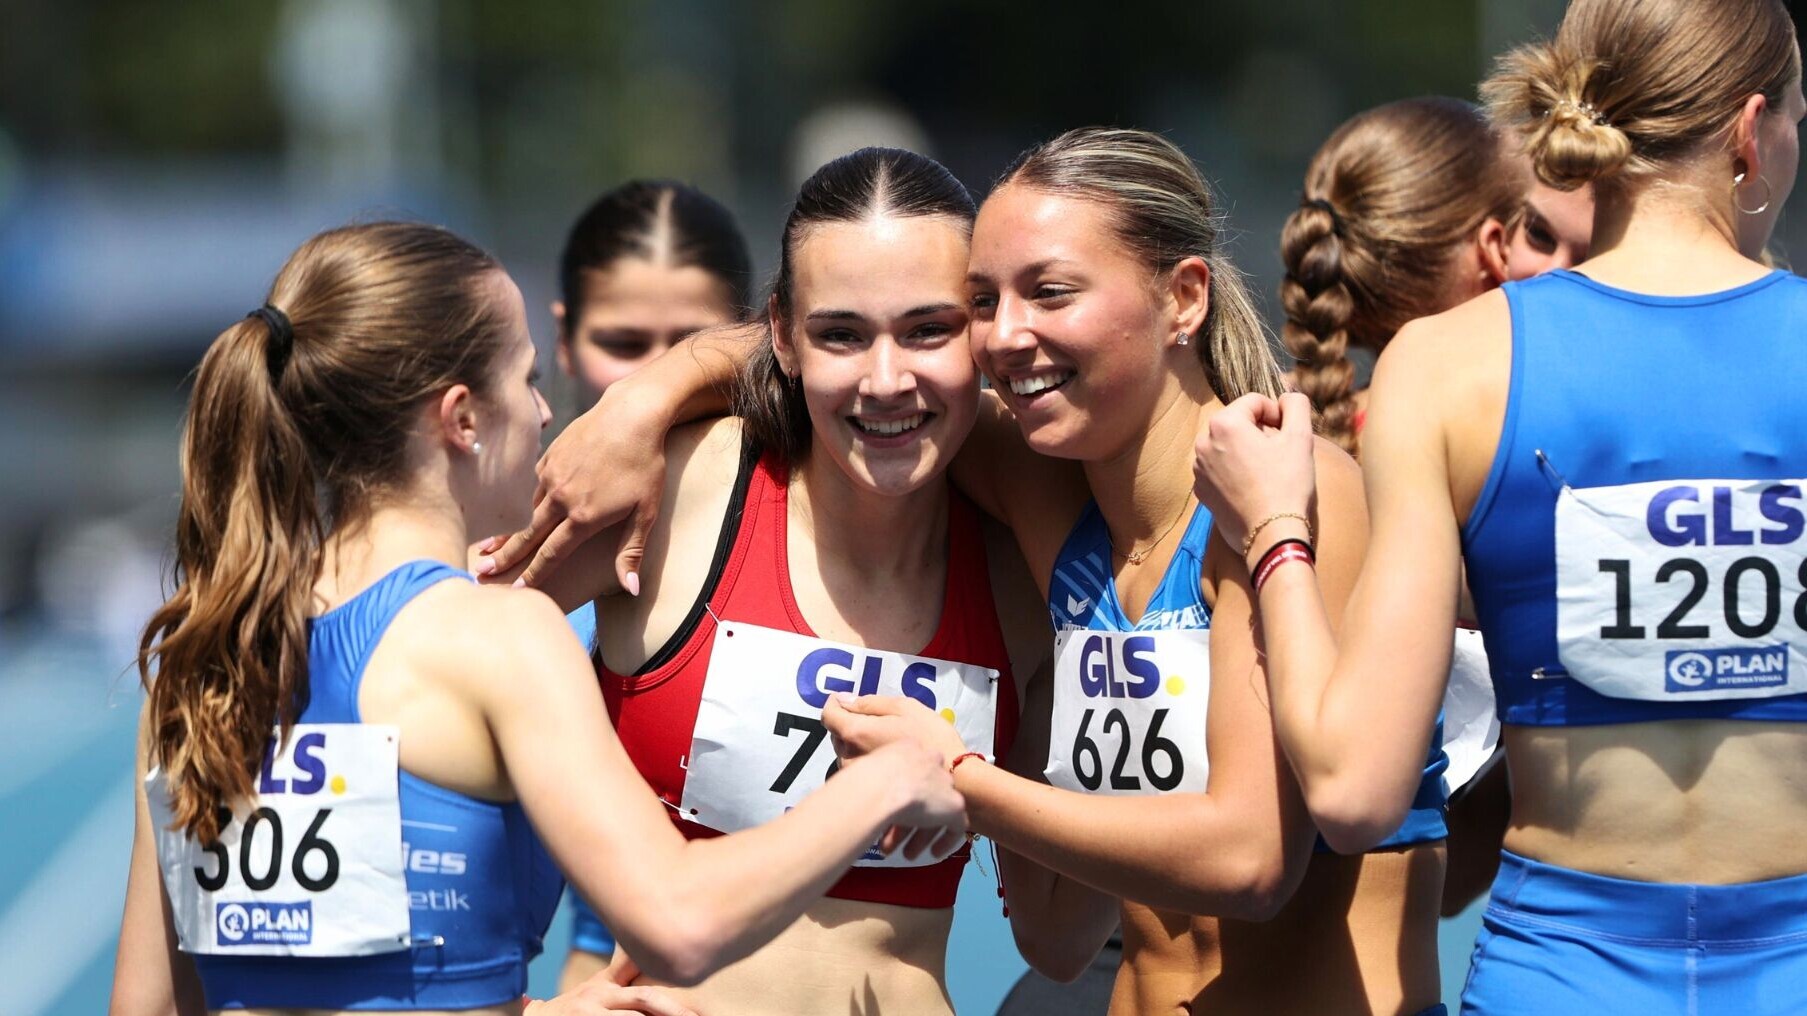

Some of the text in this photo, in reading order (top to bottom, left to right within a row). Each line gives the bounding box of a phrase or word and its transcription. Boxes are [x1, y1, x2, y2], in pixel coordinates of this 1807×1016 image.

[1646, 485, 1805, 547] GLS
[1598, 556, 1807, 639] 120
[1716, 653, 1784, 674] PLAN
[1716, 674, 1783, 685] INTERNATIONAL
[1072, 708, 1184, 791] 626
[409, 889, 471, 912] etik
[252, 908, 309, 931] PLAN
